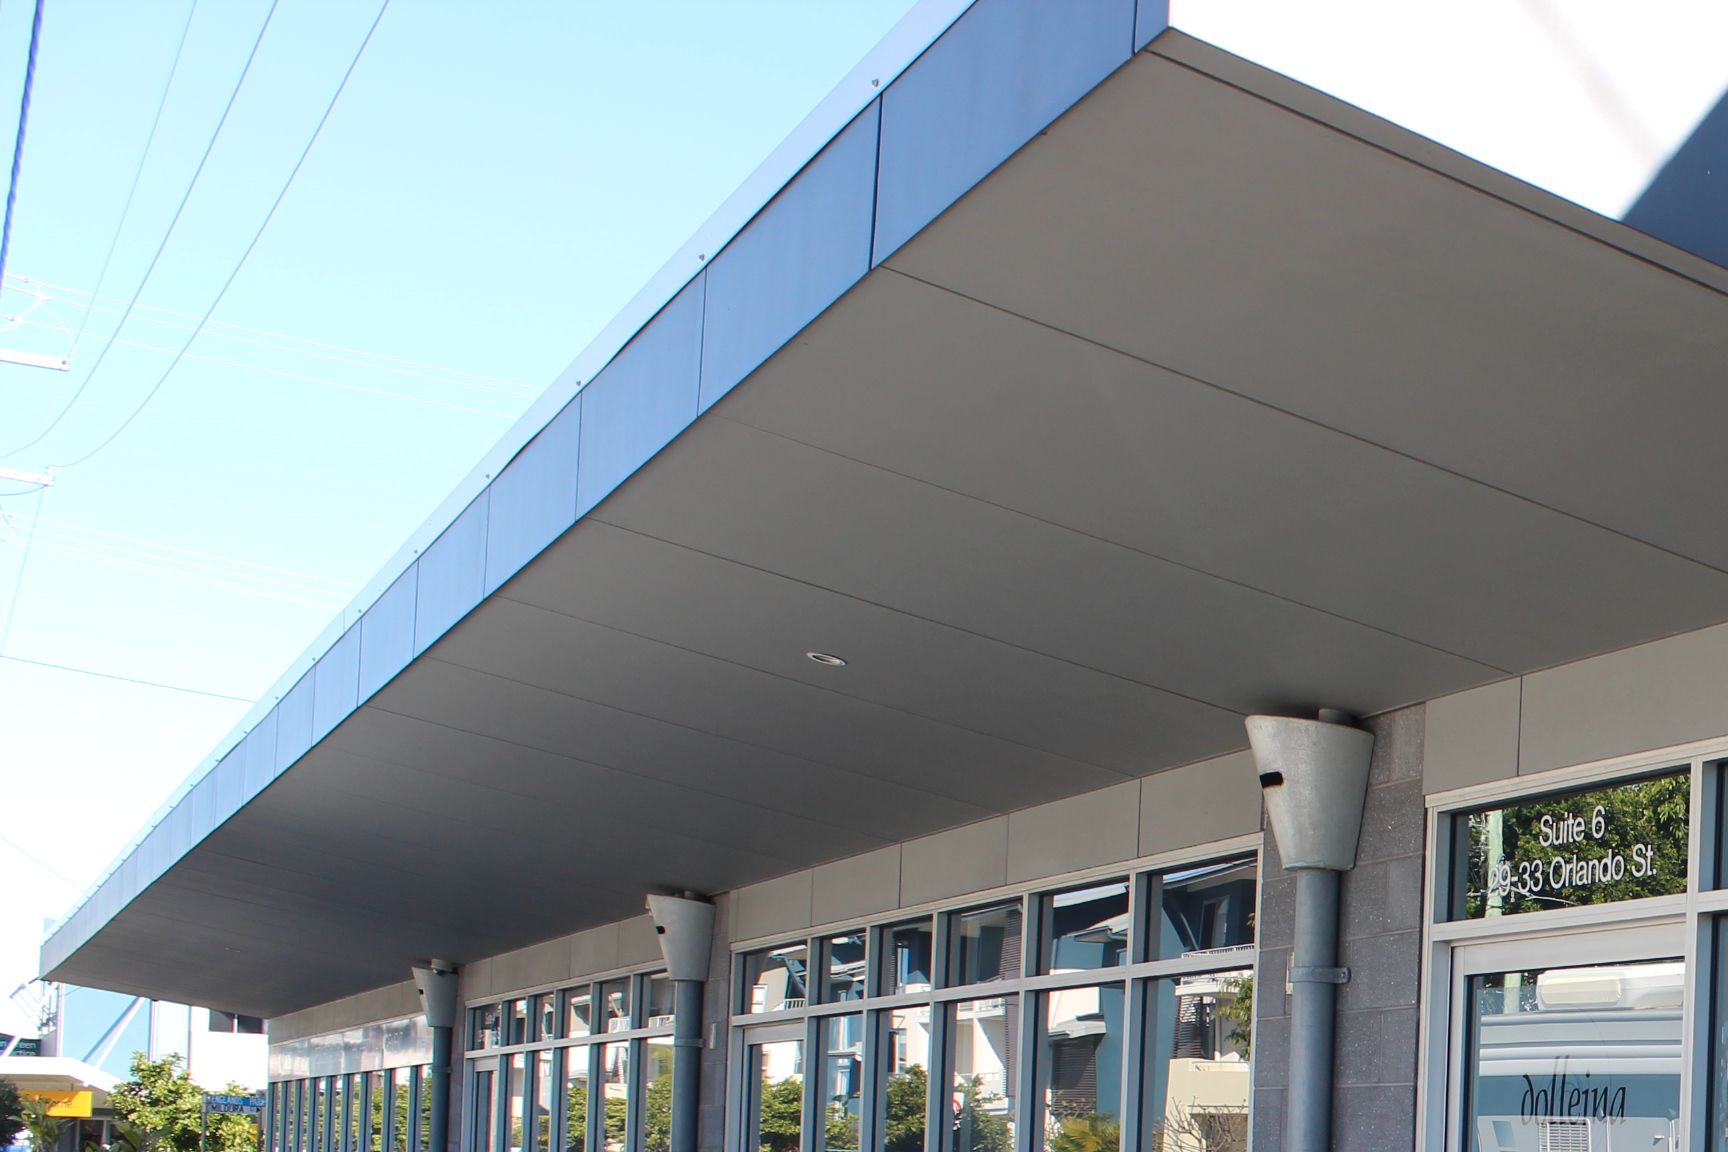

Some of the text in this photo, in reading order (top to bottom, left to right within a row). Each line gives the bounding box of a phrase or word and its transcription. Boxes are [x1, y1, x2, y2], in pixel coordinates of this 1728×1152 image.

[1539, 805, 1605, 847] Suite 6
[1488, 843, 1657, 897] 29-33 Orlando St.
